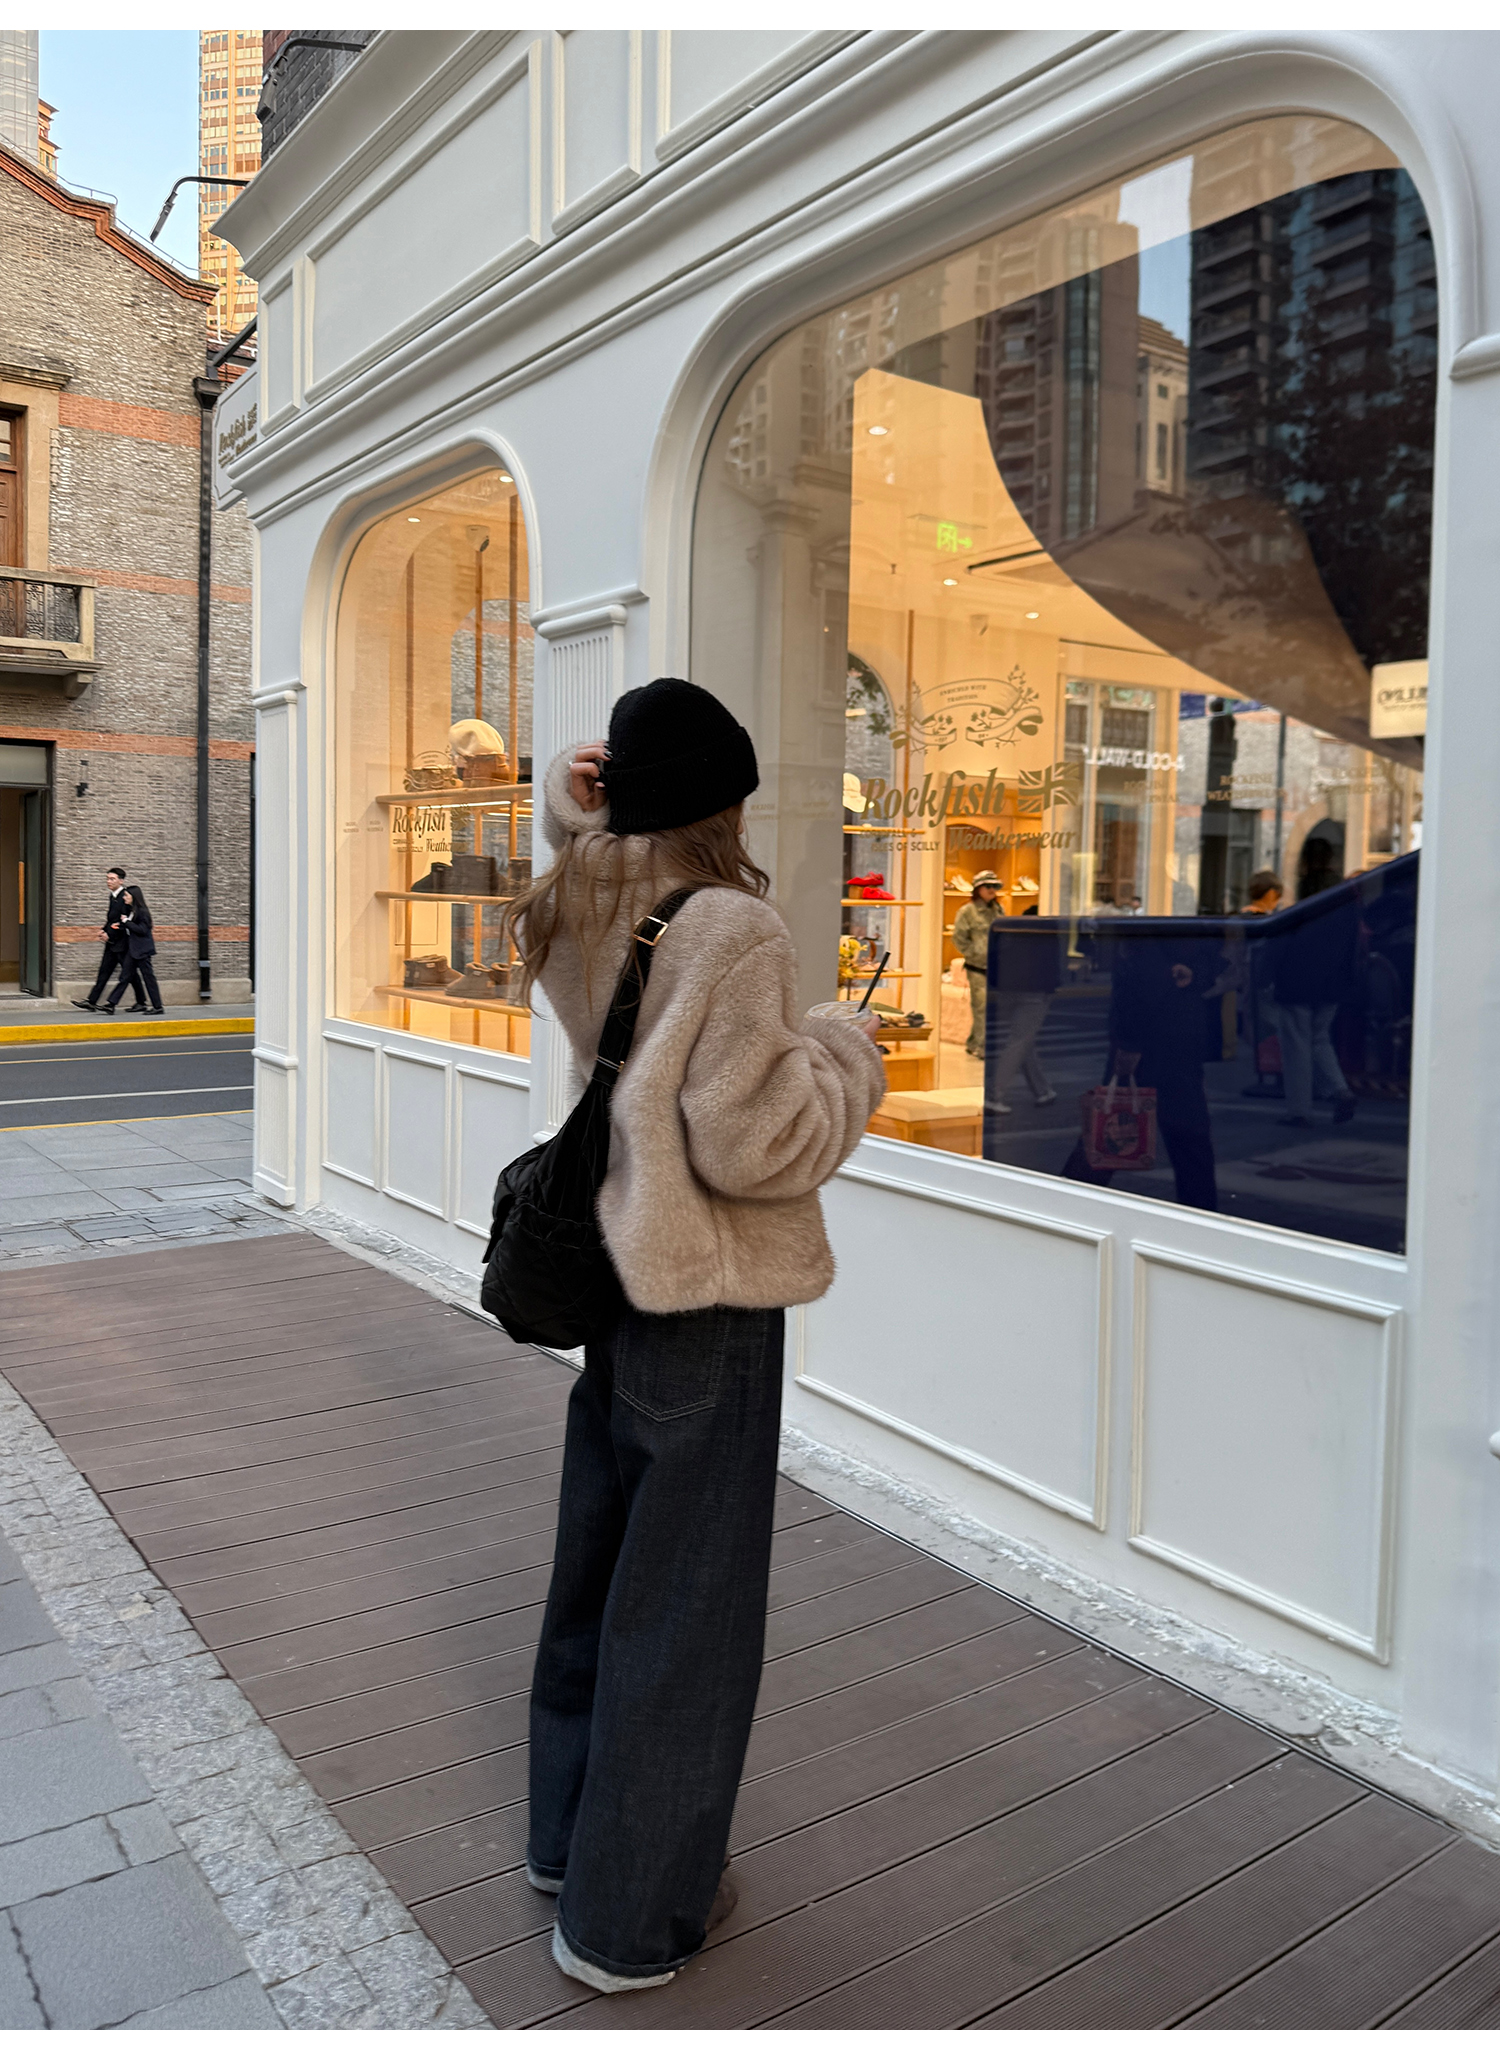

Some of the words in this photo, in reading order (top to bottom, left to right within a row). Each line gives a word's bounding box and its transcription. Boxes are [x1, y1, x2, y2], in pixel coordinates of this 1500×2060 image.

[860, 767, 1006, 828] Rockfish
[393, 805, 446, 838] Rockfish
[896, 842, 908, 851] OF
[911, 841, 940, 851] SCILLY
[949, 826, 1077, 850] Weatherwear
